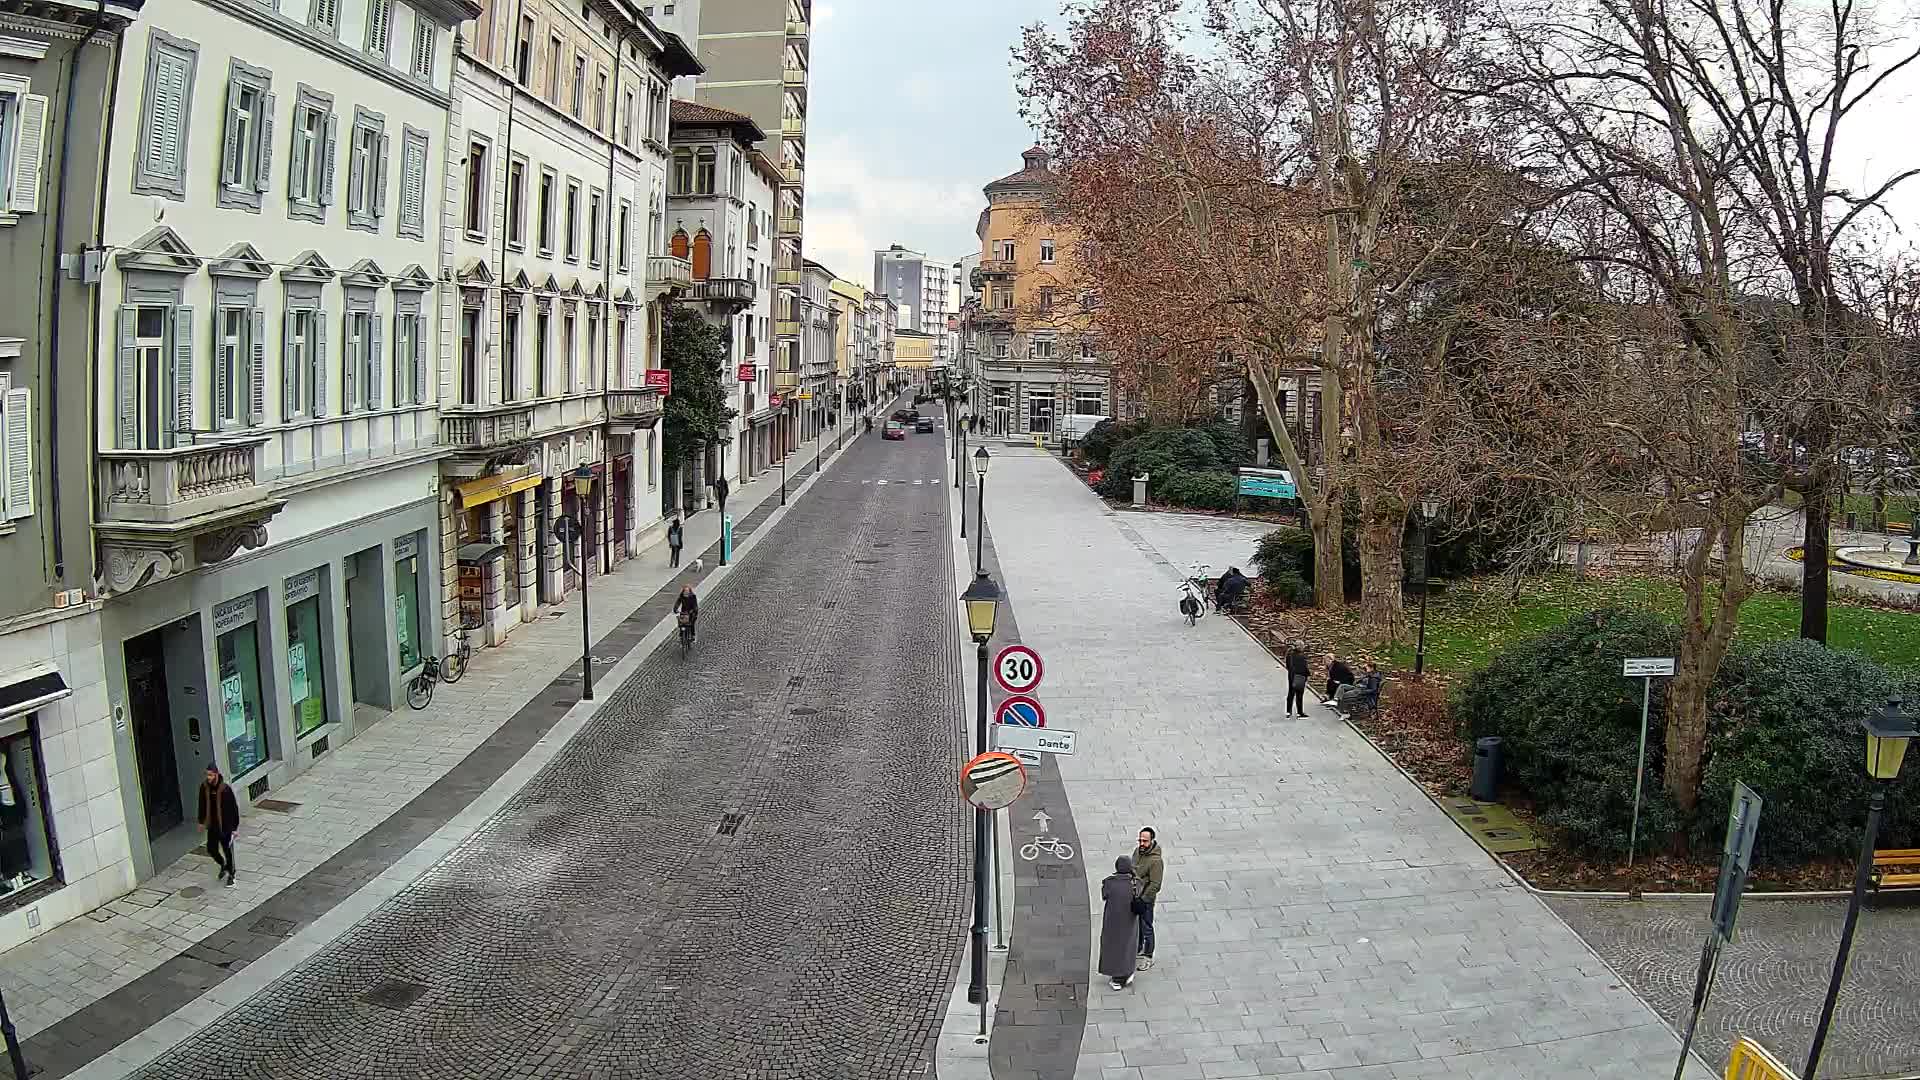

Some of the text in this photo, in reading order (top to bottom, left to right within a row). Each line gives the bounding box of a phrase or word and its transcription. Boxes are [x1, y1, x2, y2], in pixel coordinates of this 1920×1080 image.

[1005, 658, 1033, 681] 30
[223, 678, 240, 700] 130
[1038, 738, 1070, 750] Dante
